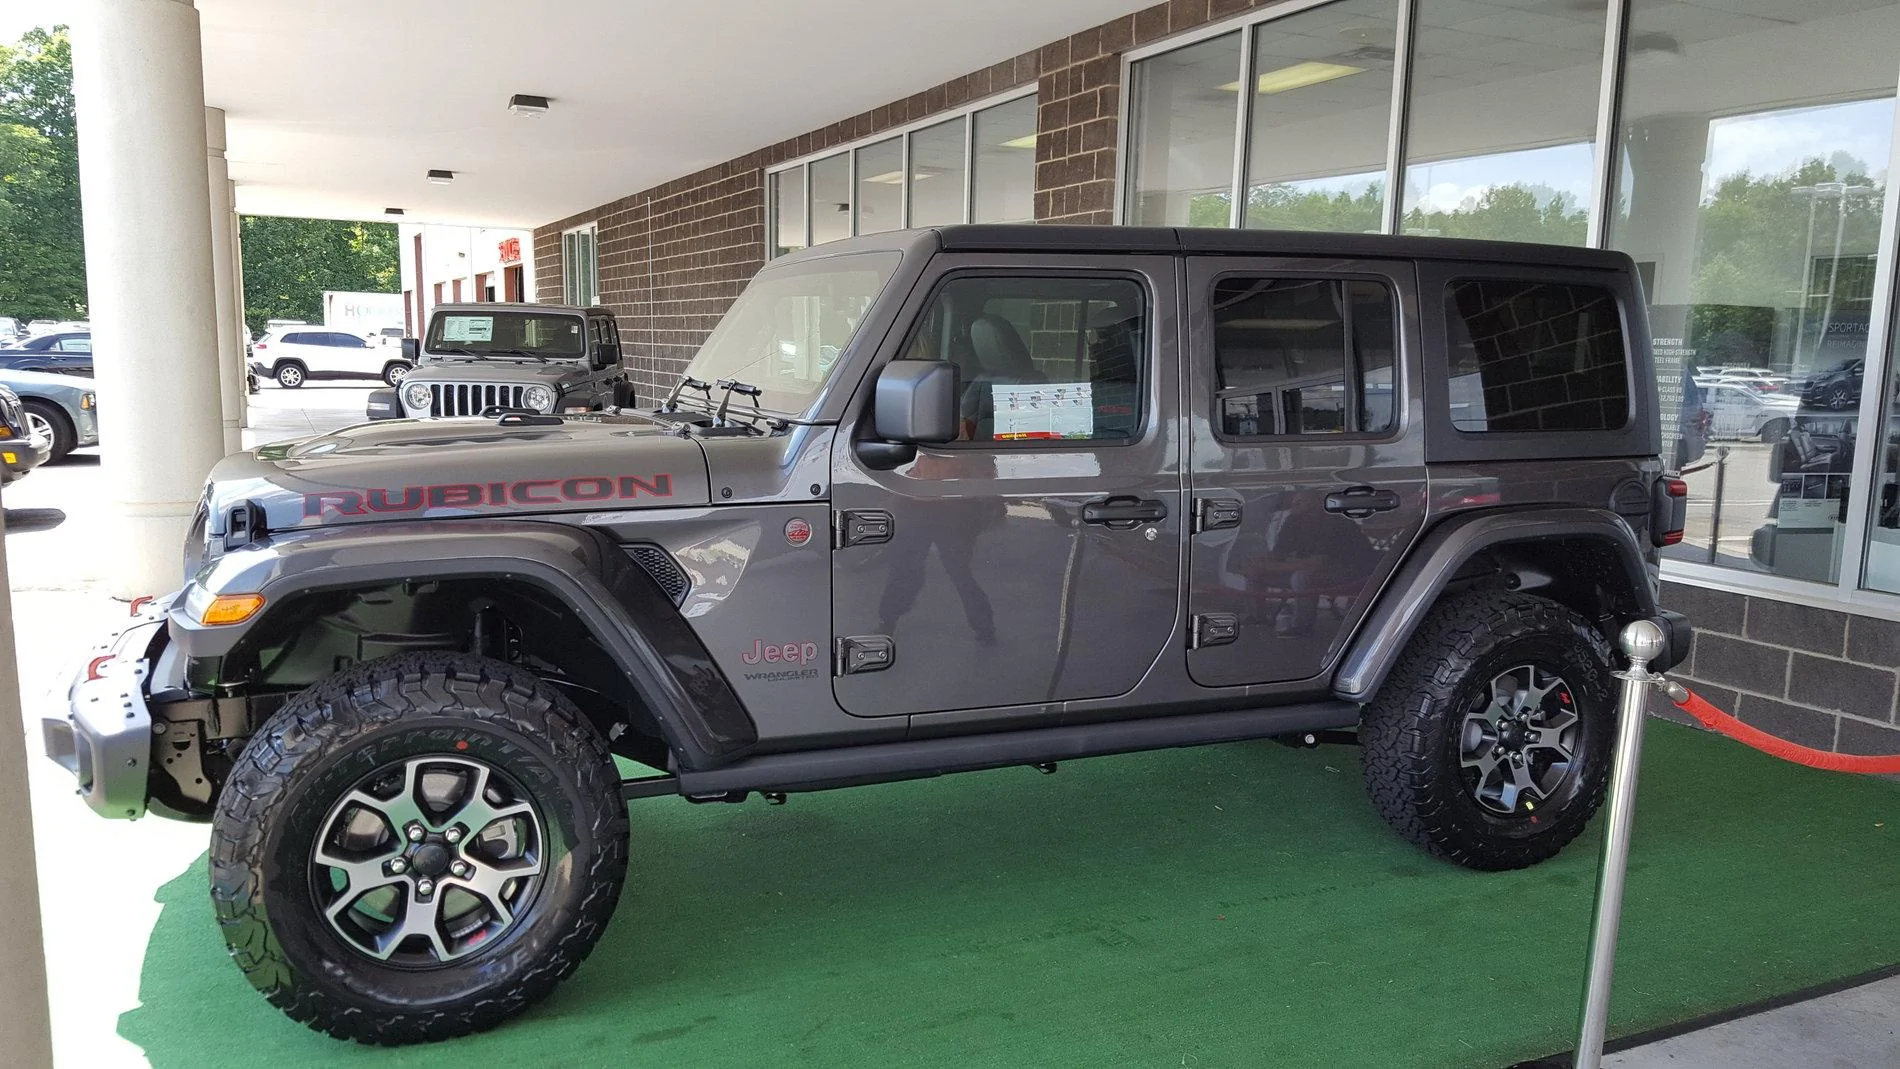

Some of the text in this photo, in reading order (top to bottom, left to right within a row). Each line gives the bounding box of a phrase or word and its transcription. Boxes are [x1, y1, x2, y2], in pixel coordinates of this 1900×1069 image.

[1652, 338, 1682, 346] STRENGTH
[1657, 375, 1682, 383] ABILITY
[1660, 413, 1679, 421] OLOGY
[303, 473, 672, 518] RUBICON
[742, 640, 819, 667] Jeep
[743, 668, 818, 681] WRANGLER
